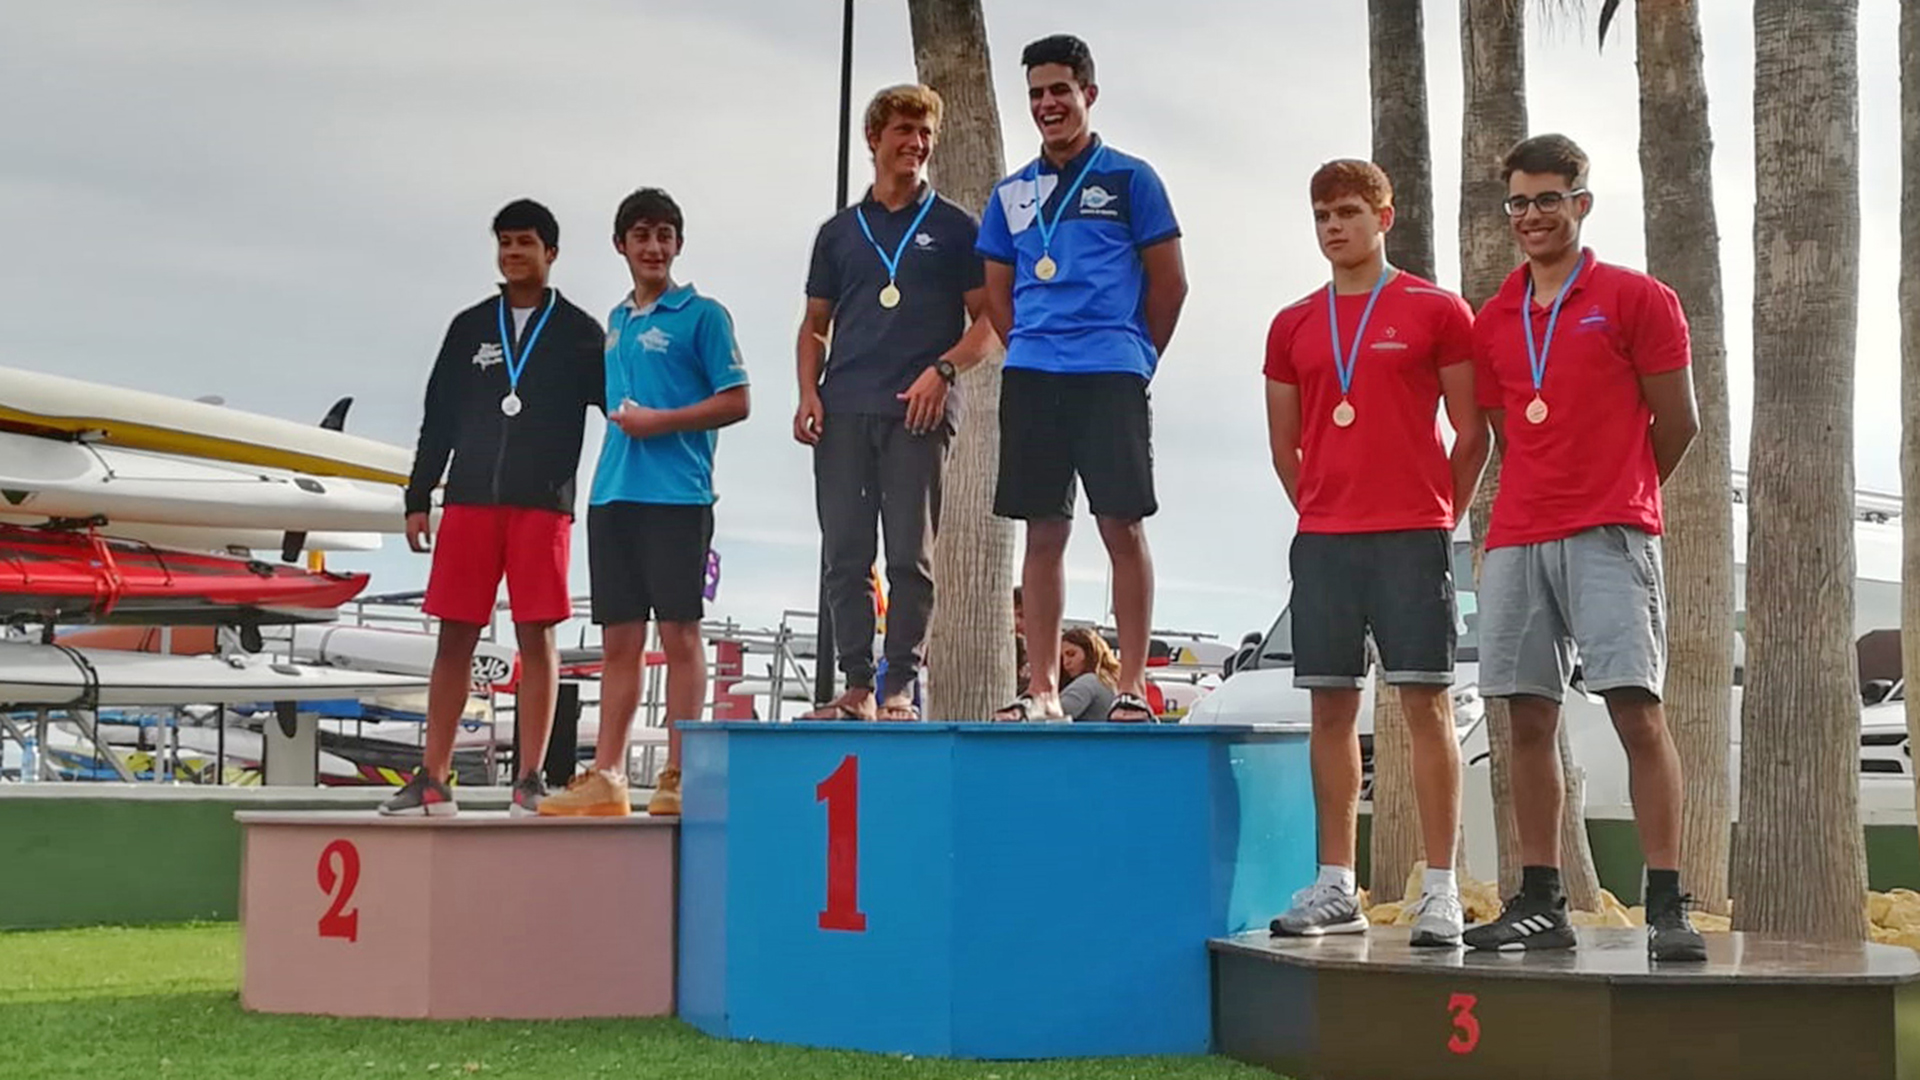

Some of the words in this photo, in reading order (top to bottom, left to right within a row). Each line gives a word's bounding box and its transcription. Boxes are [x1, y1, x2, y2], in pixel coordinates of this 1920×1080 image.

[317, 839, 360, 942] 2
[816, 754, 867, 932] 1
[1447, 992, 1480, 1054] 3
